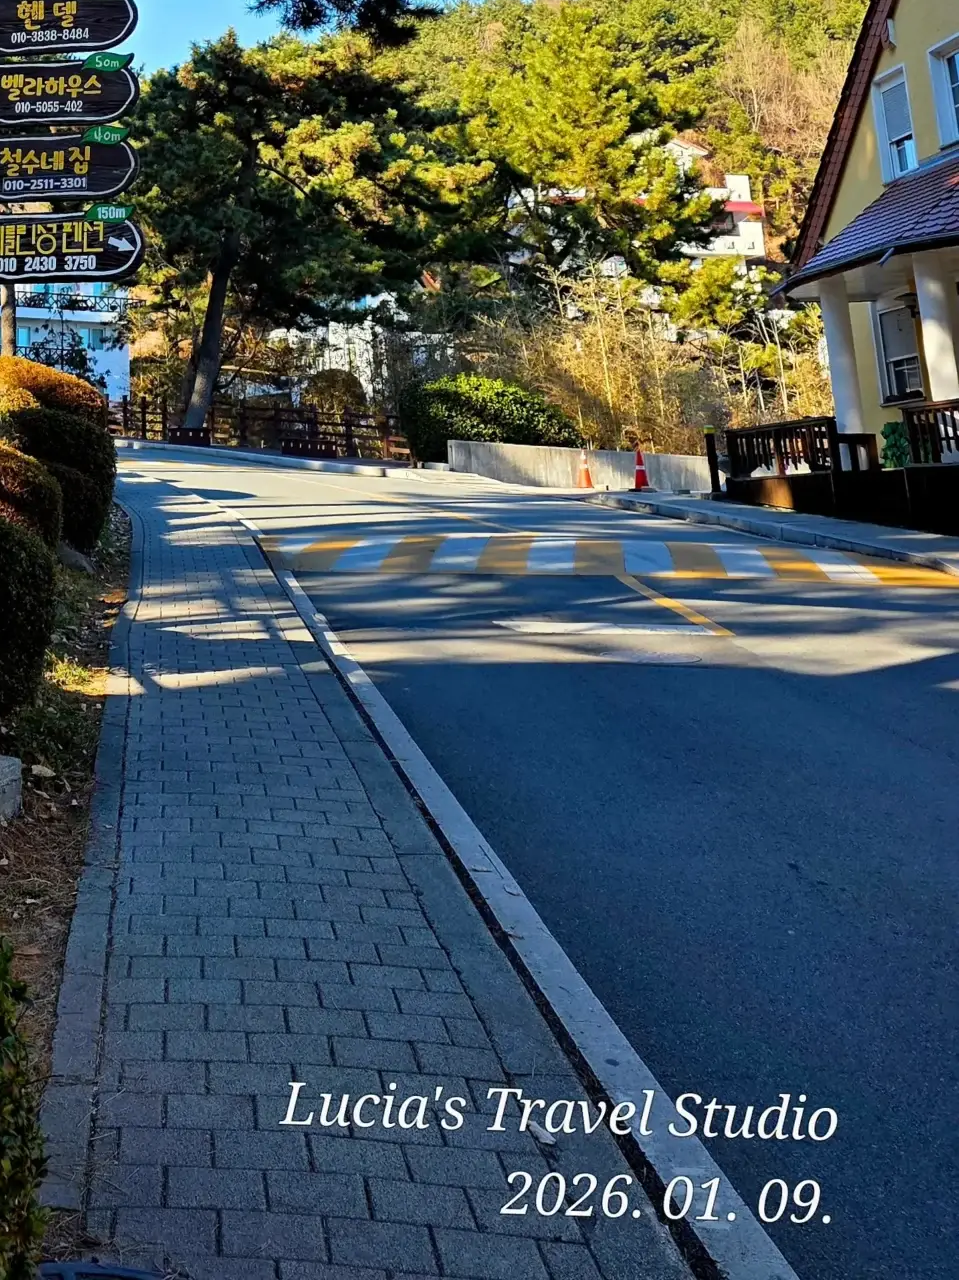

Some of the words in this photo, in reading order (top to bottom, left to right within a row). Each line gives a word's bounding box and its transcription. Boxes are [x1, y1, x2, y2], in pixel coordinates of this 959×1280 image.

[11, 27, 89, 44] 010-3838-8484
[95, 56, 119, 68] 50m
[1, 74, 101, 101] 벨라하우스
[15, 100, 83, 113] 010-5055-402
[94, 126, 120, 141] 40m
[3, 177, 86, 191] 010-2511-3301
[97, 206, 125, 219] 150m
[24, 255, 57, 271] 2430
[64, 254, 96, 270] 3750
